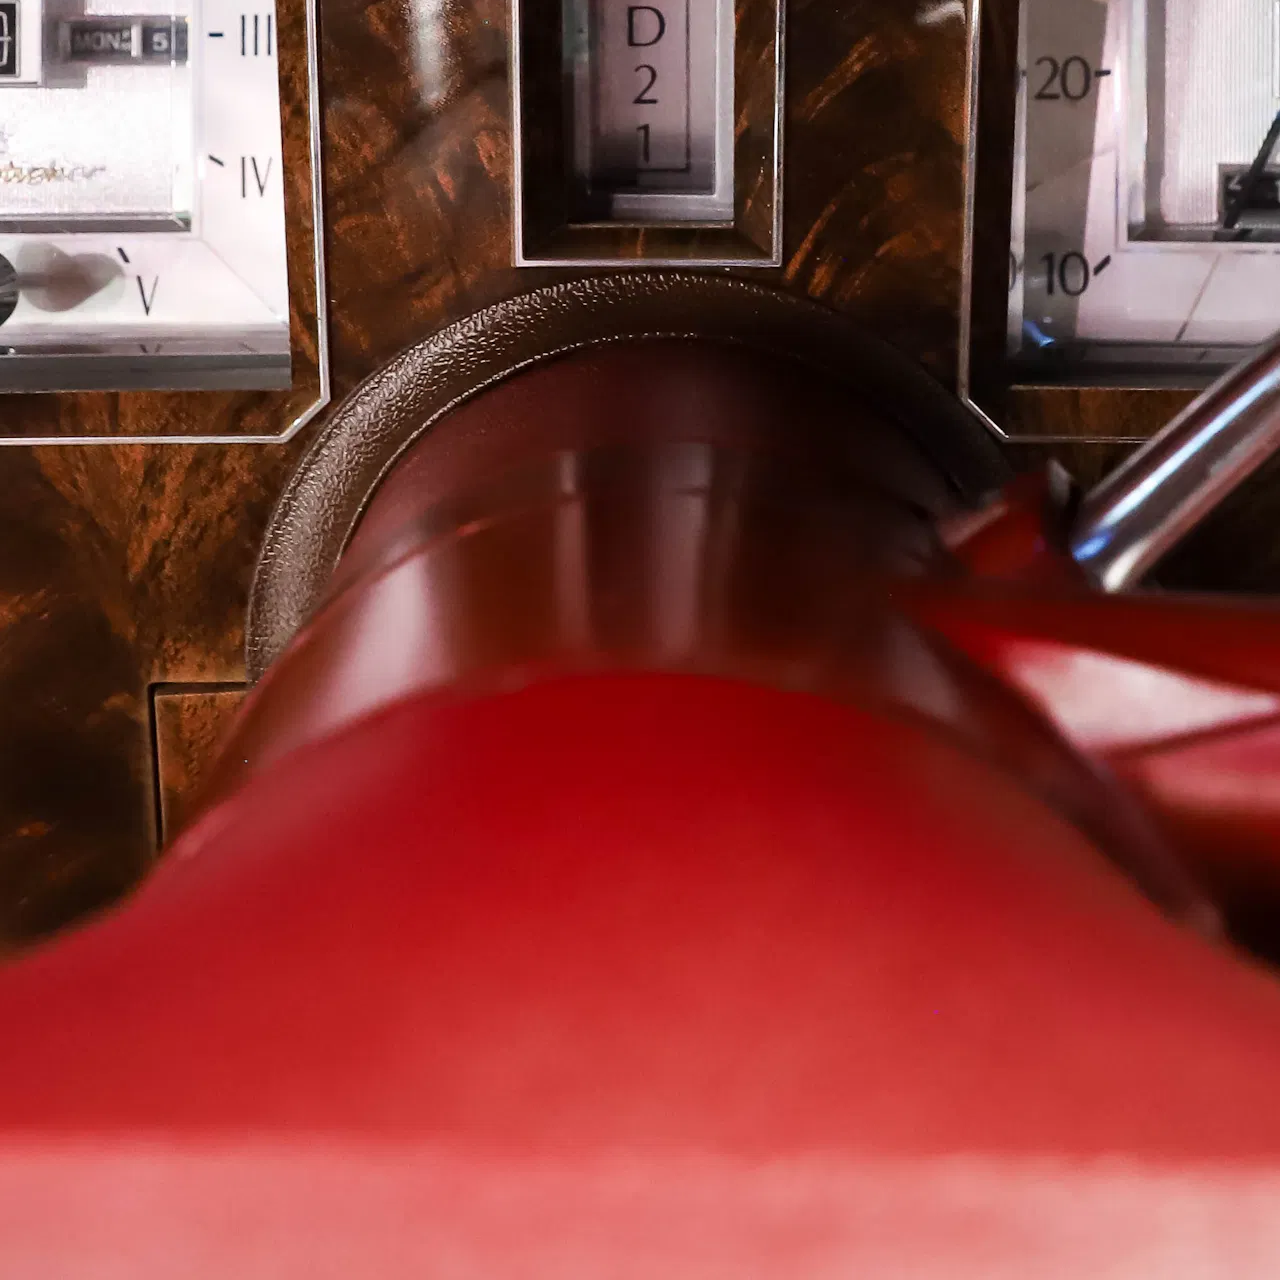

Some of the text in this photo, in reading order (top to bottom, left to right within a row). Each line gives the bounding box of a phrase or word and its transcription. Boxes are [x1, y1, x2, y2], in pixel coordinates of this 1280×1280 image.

[152, 31, 169, 52] 5
[240, 14, 272, 57] III
[626, 5, 666, 48] D
[632, 64, 659, 106] 2
[1033, 54, 1093, 101] 20
[636, 124, 652, 164] 1
[241, 156, 273, 199] IV
[1041, 251, 1091, 297] 10
[135, 275, 160, 317] V
